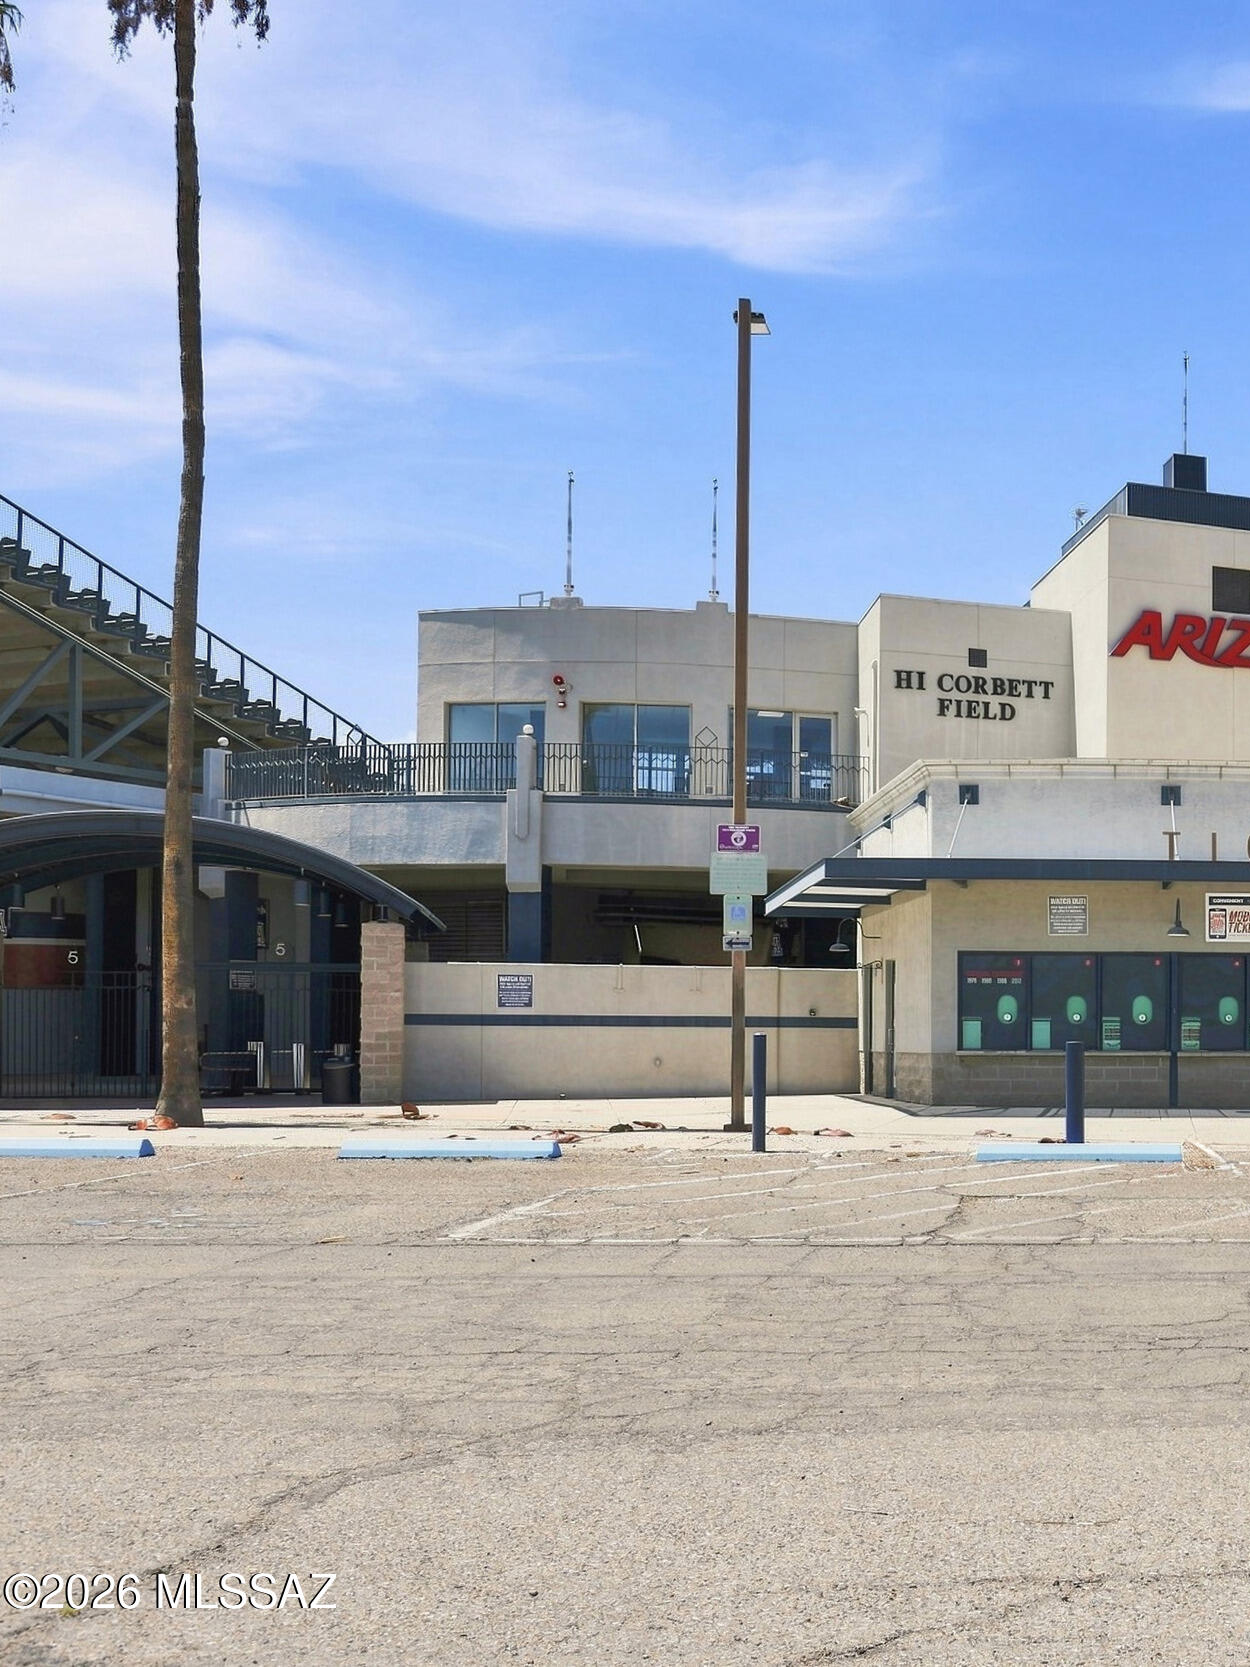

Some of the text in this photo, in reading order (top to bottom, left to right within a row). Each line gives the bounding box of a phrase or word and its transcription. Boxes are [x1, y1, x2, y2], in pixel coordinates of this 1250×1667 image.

[893, 669, 1055, 700] HI CORBETT
[936, 697, 1016, 721] FIELD
[67, 951, 79, 964] 5
[275, 943, 286, 956] 5
